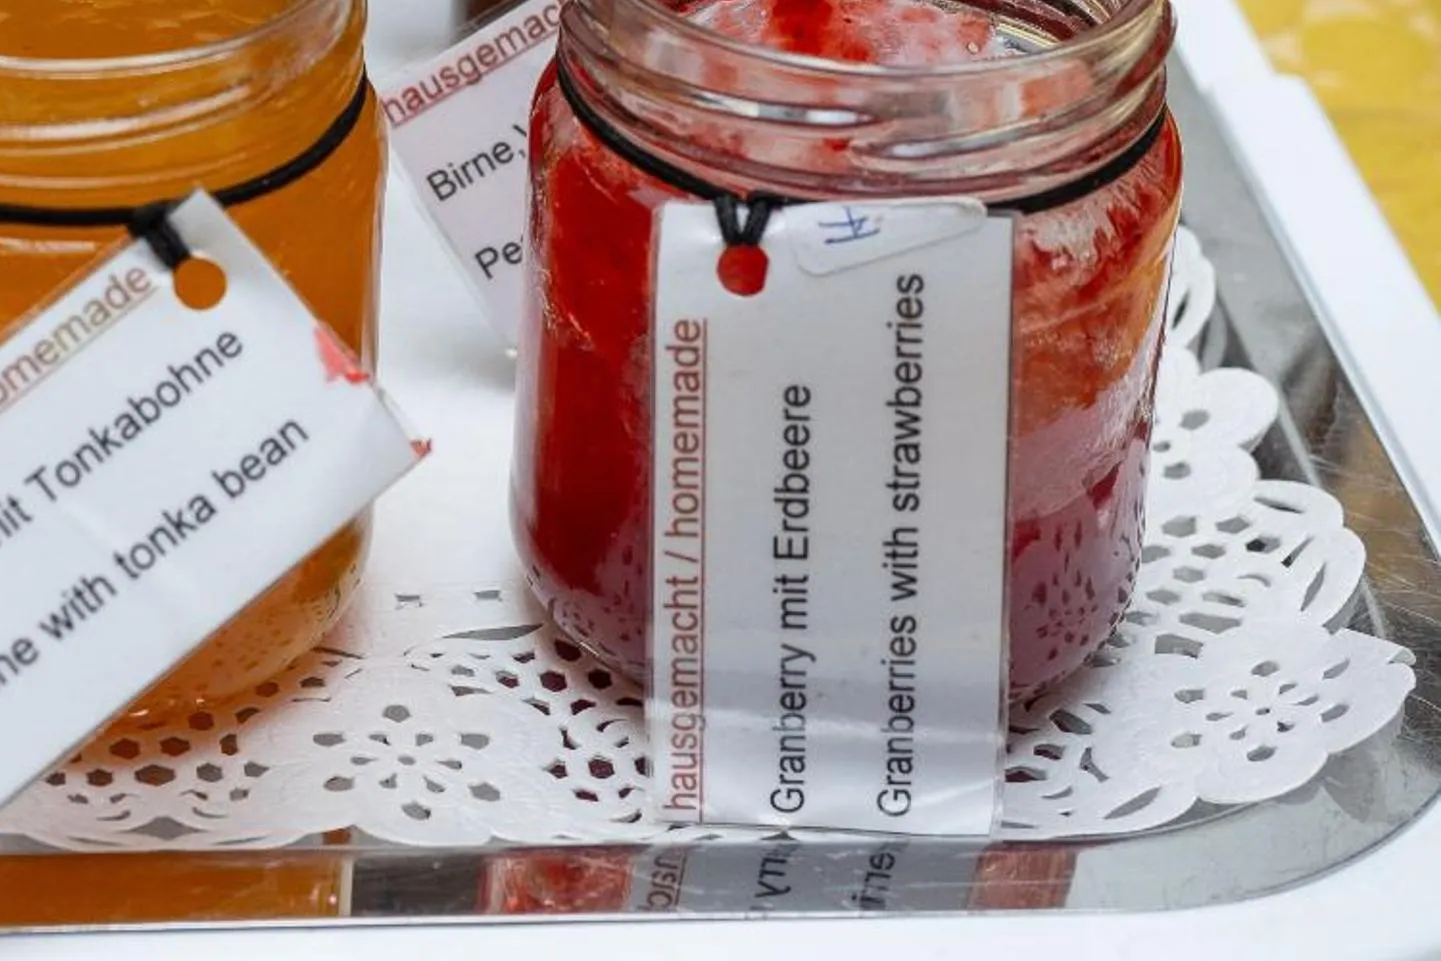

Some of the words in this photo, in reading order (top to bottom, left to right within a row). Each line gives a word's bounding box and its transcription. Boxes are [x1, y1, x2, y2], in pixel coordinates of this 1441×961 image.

[474, 235, 524, 280] Pe
[24, 327, 245, 505] Tonkabohne
[665, 318, 706, 540] homemade
[772, 382, 813, 560] Erdbeere
[885, 273, 925, 514] strawberries
[40, 574, 118, 642] with
[117, 494, 217, 583] tonka
[212, 415, 311, 501] bean
[773, 572, 810, 632] mit
[882, 526, 921, 606] with
[663, 575, 707, 812] hausgemacht
[770, 642, 817, 816] Granberry
[877, 610, 919, 818] Granberries
